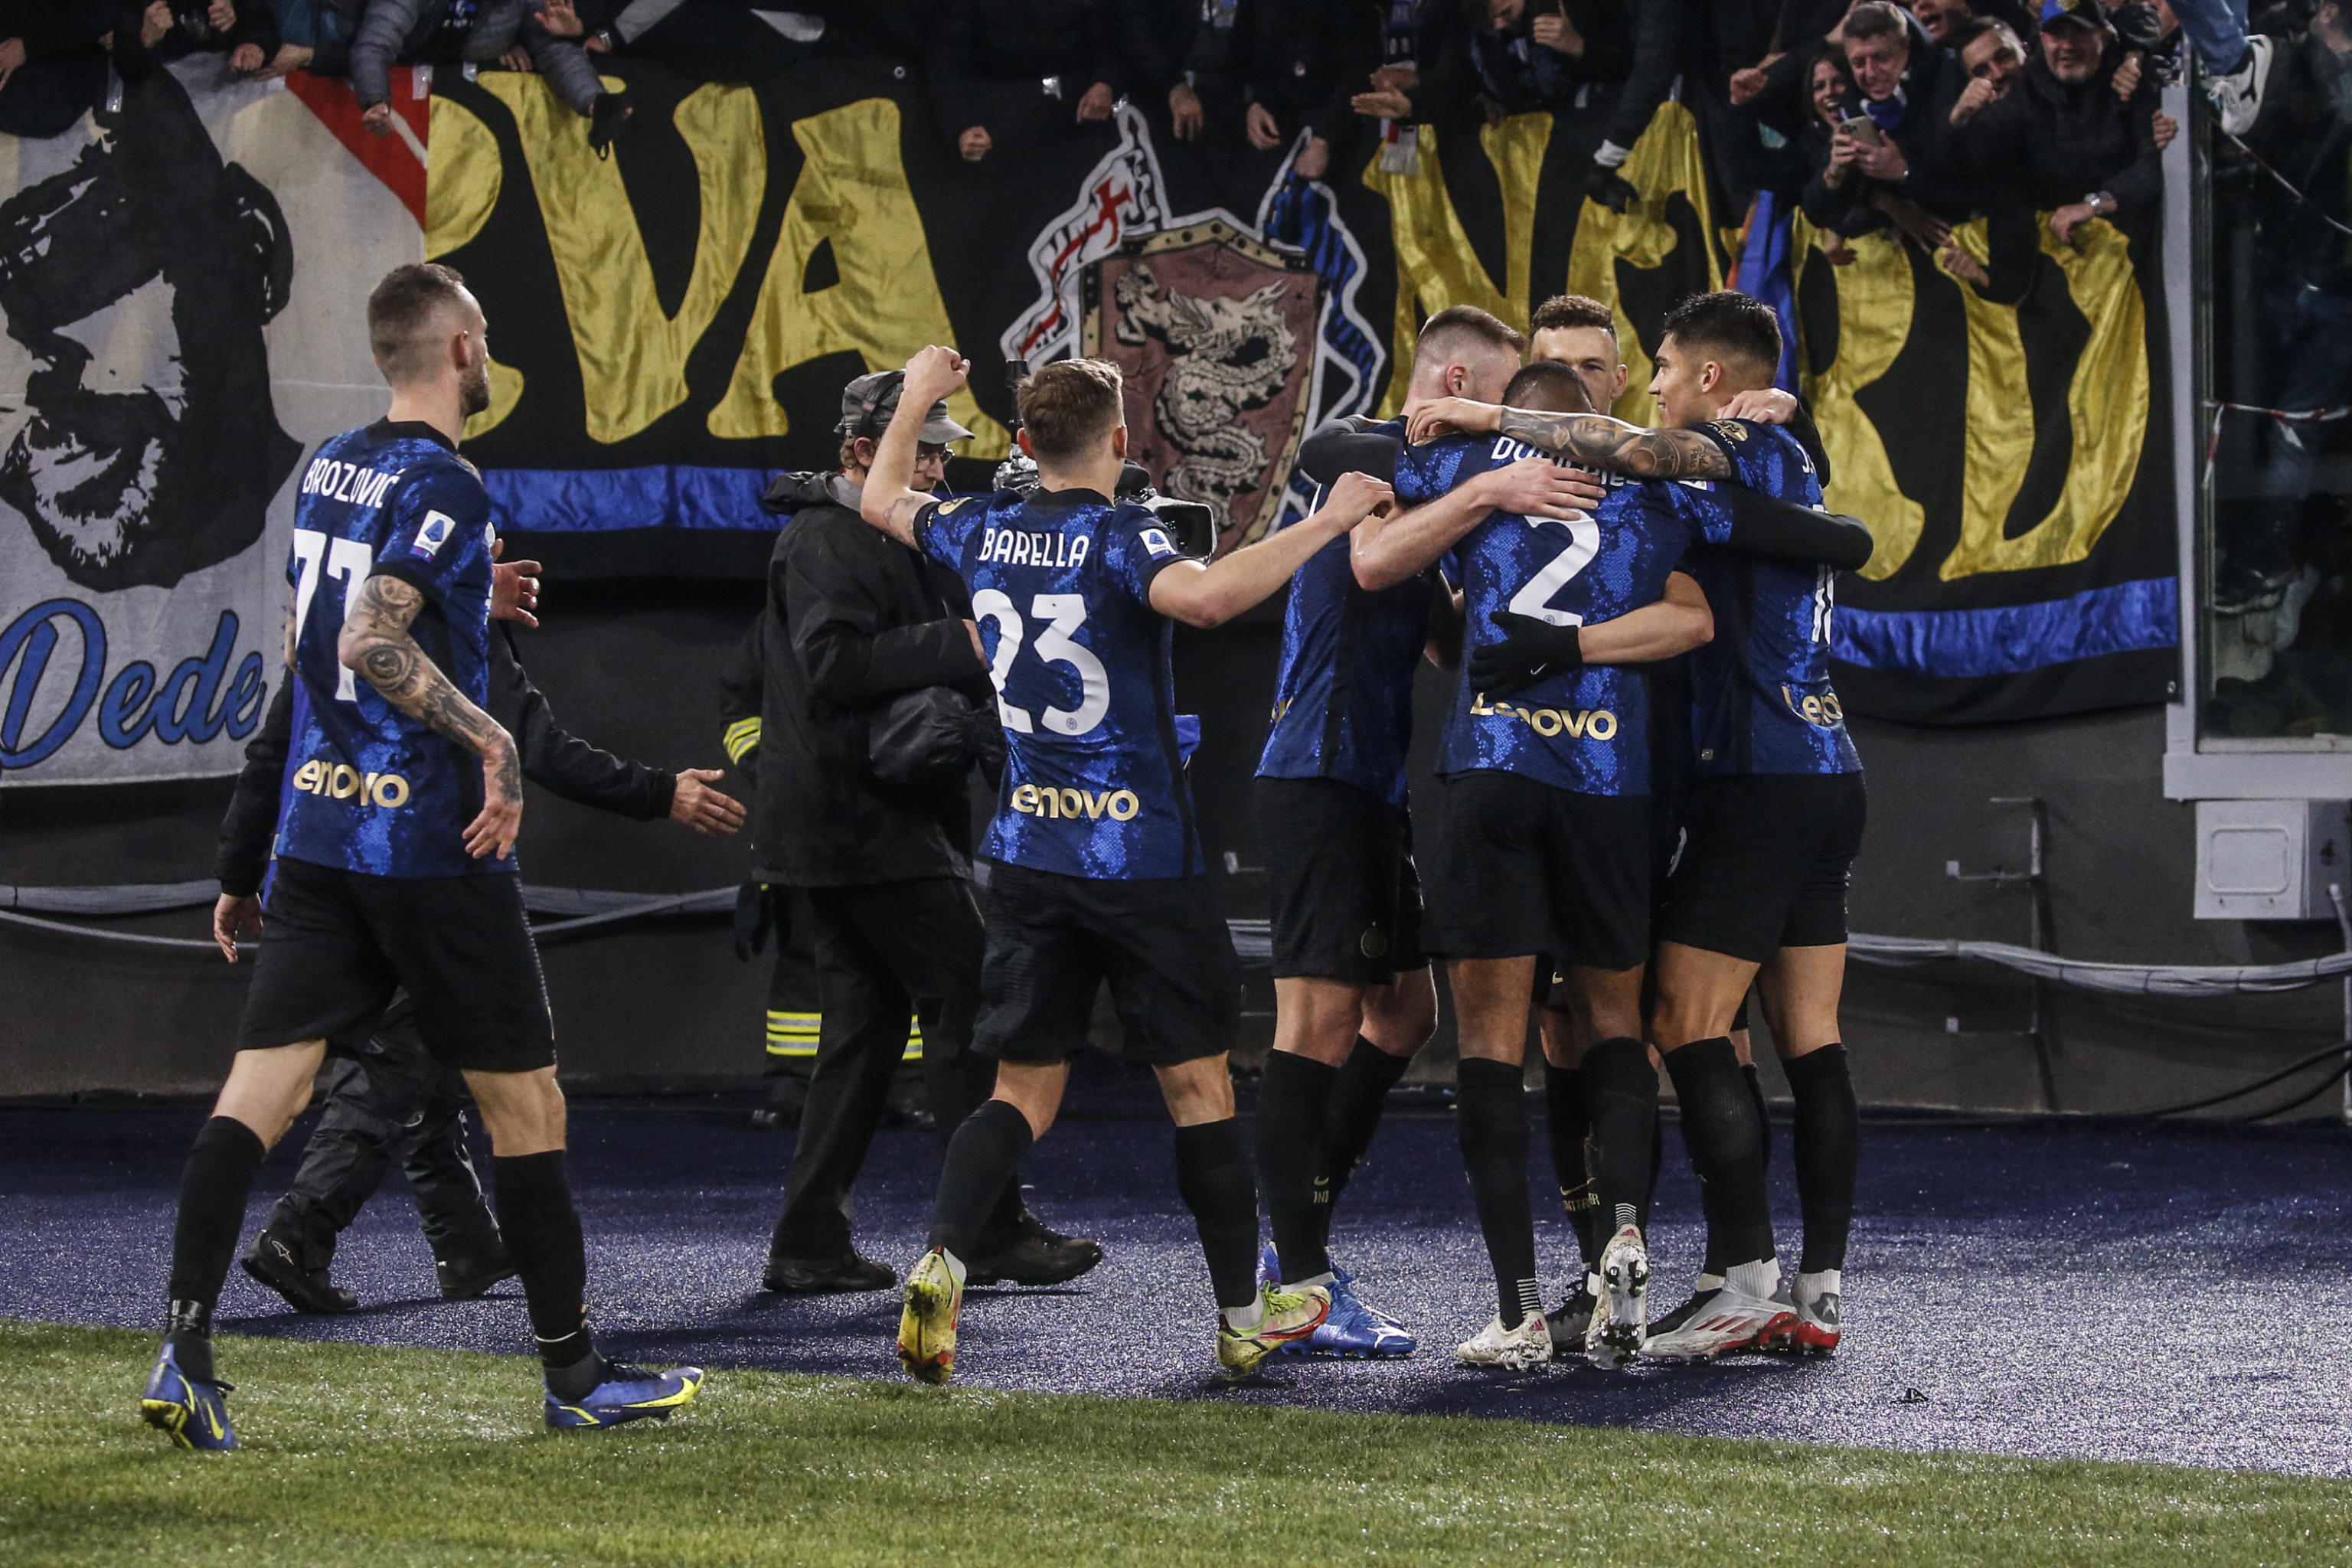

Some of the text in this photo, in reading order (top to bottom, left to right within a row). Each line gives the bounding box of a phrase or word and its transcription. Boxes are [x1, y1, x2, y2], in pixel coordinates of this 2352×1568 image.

[302, 458, 407, 508] BROZOVIĆ
[978, 528, 1090, 568] BARELLA
[1508, 508, 1600, 628] 2
[293, 528, 373, 702] 77
[972, 588, 1110, 736] 23
[0, 597, 267, 770] Dede
[1010, 783, 1140, 822] enovo
